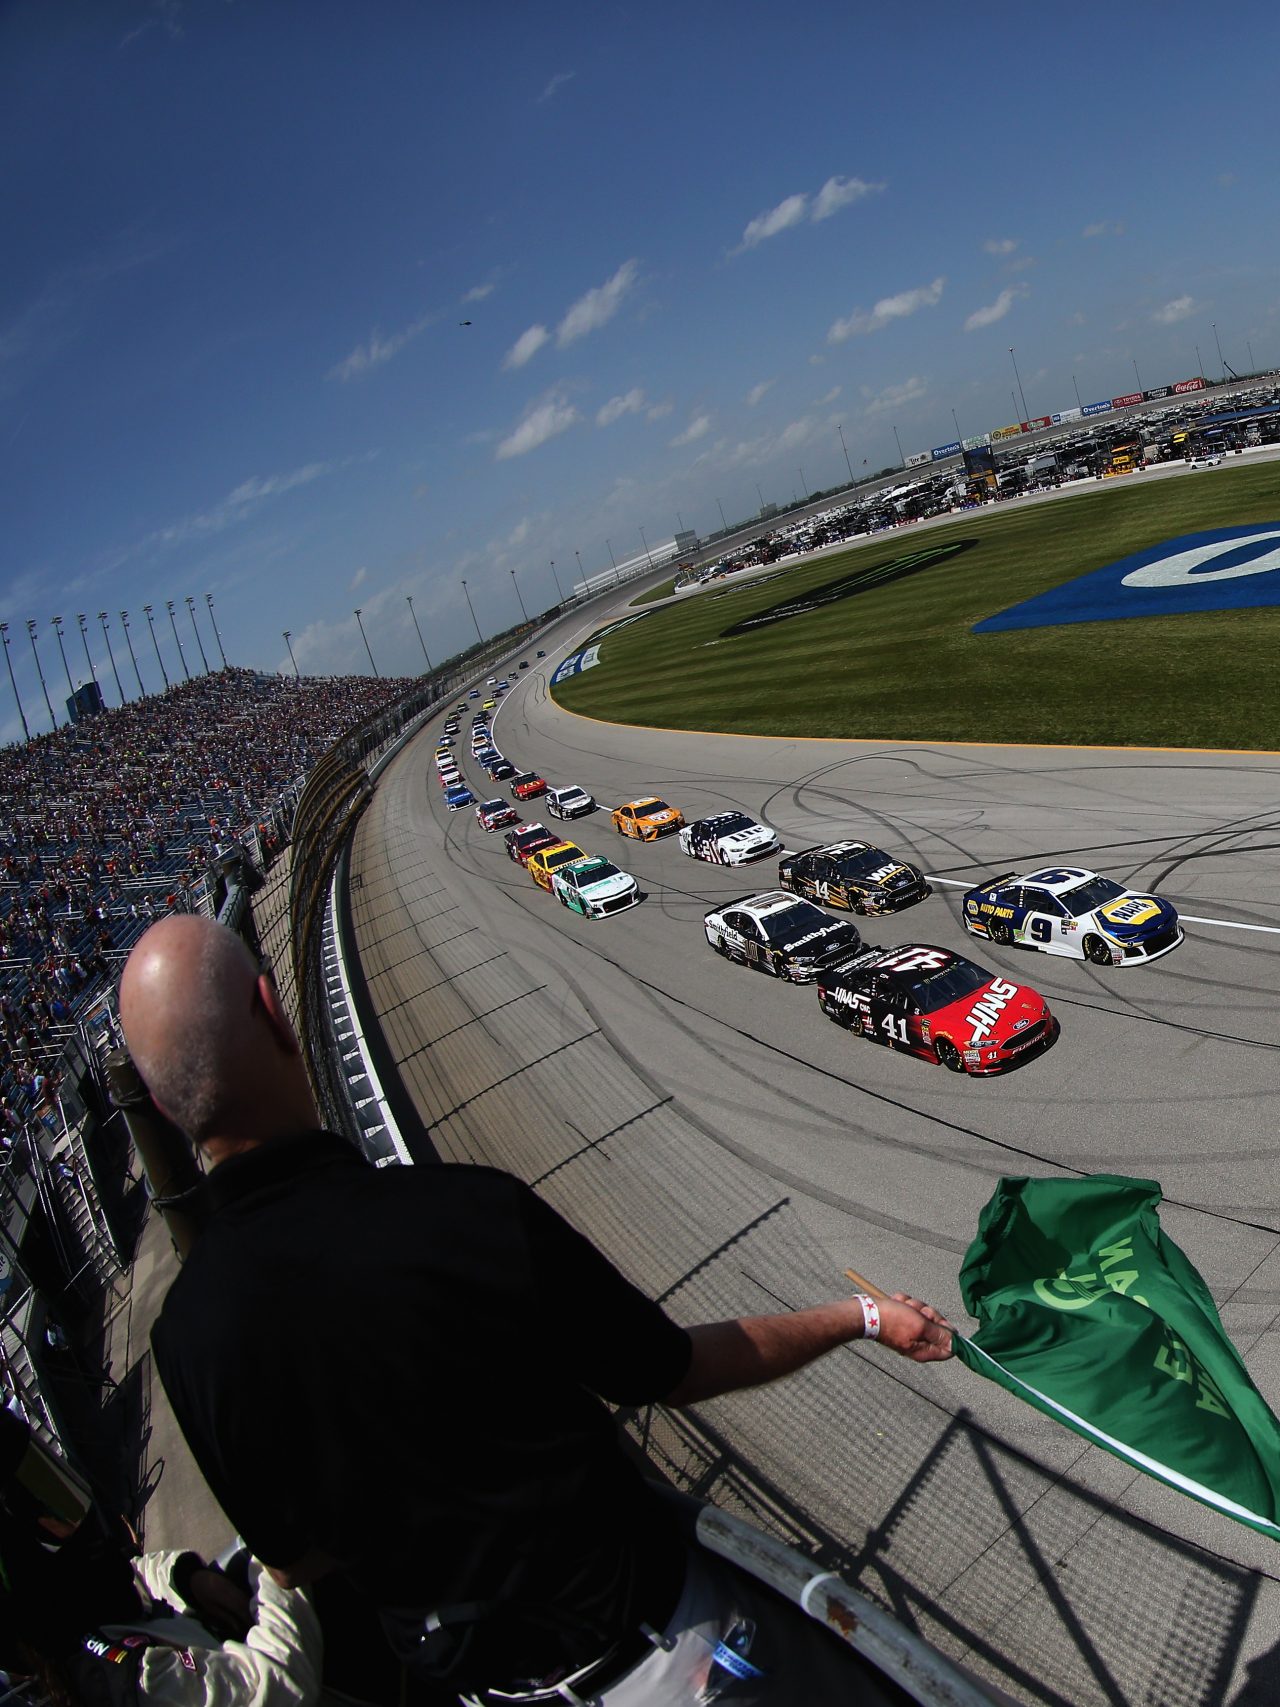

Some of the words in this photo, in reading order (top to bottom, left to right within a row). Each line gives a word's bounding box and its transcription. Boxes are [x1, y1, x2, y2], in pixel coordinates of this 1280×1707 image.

[866, 862, 903, 882] WIX
[814, 879, 830, 900] 14
[980, 902, 995, 915] AUTO
[994, 906, 1015, 919] PARTS
[709, 920, 739, 940] Smithfield
[783, 919, 850, 952] Smithfield
[1031, 917, 1053, 944] 9
[878, 947, 950, 972] 41
[826, 987, 872, 1009] HAAS
[965, 977, 1018, 1042] HAAS
[881, 1013, 911, 1045] 41
[987, 1051, 997, 1060] 41
